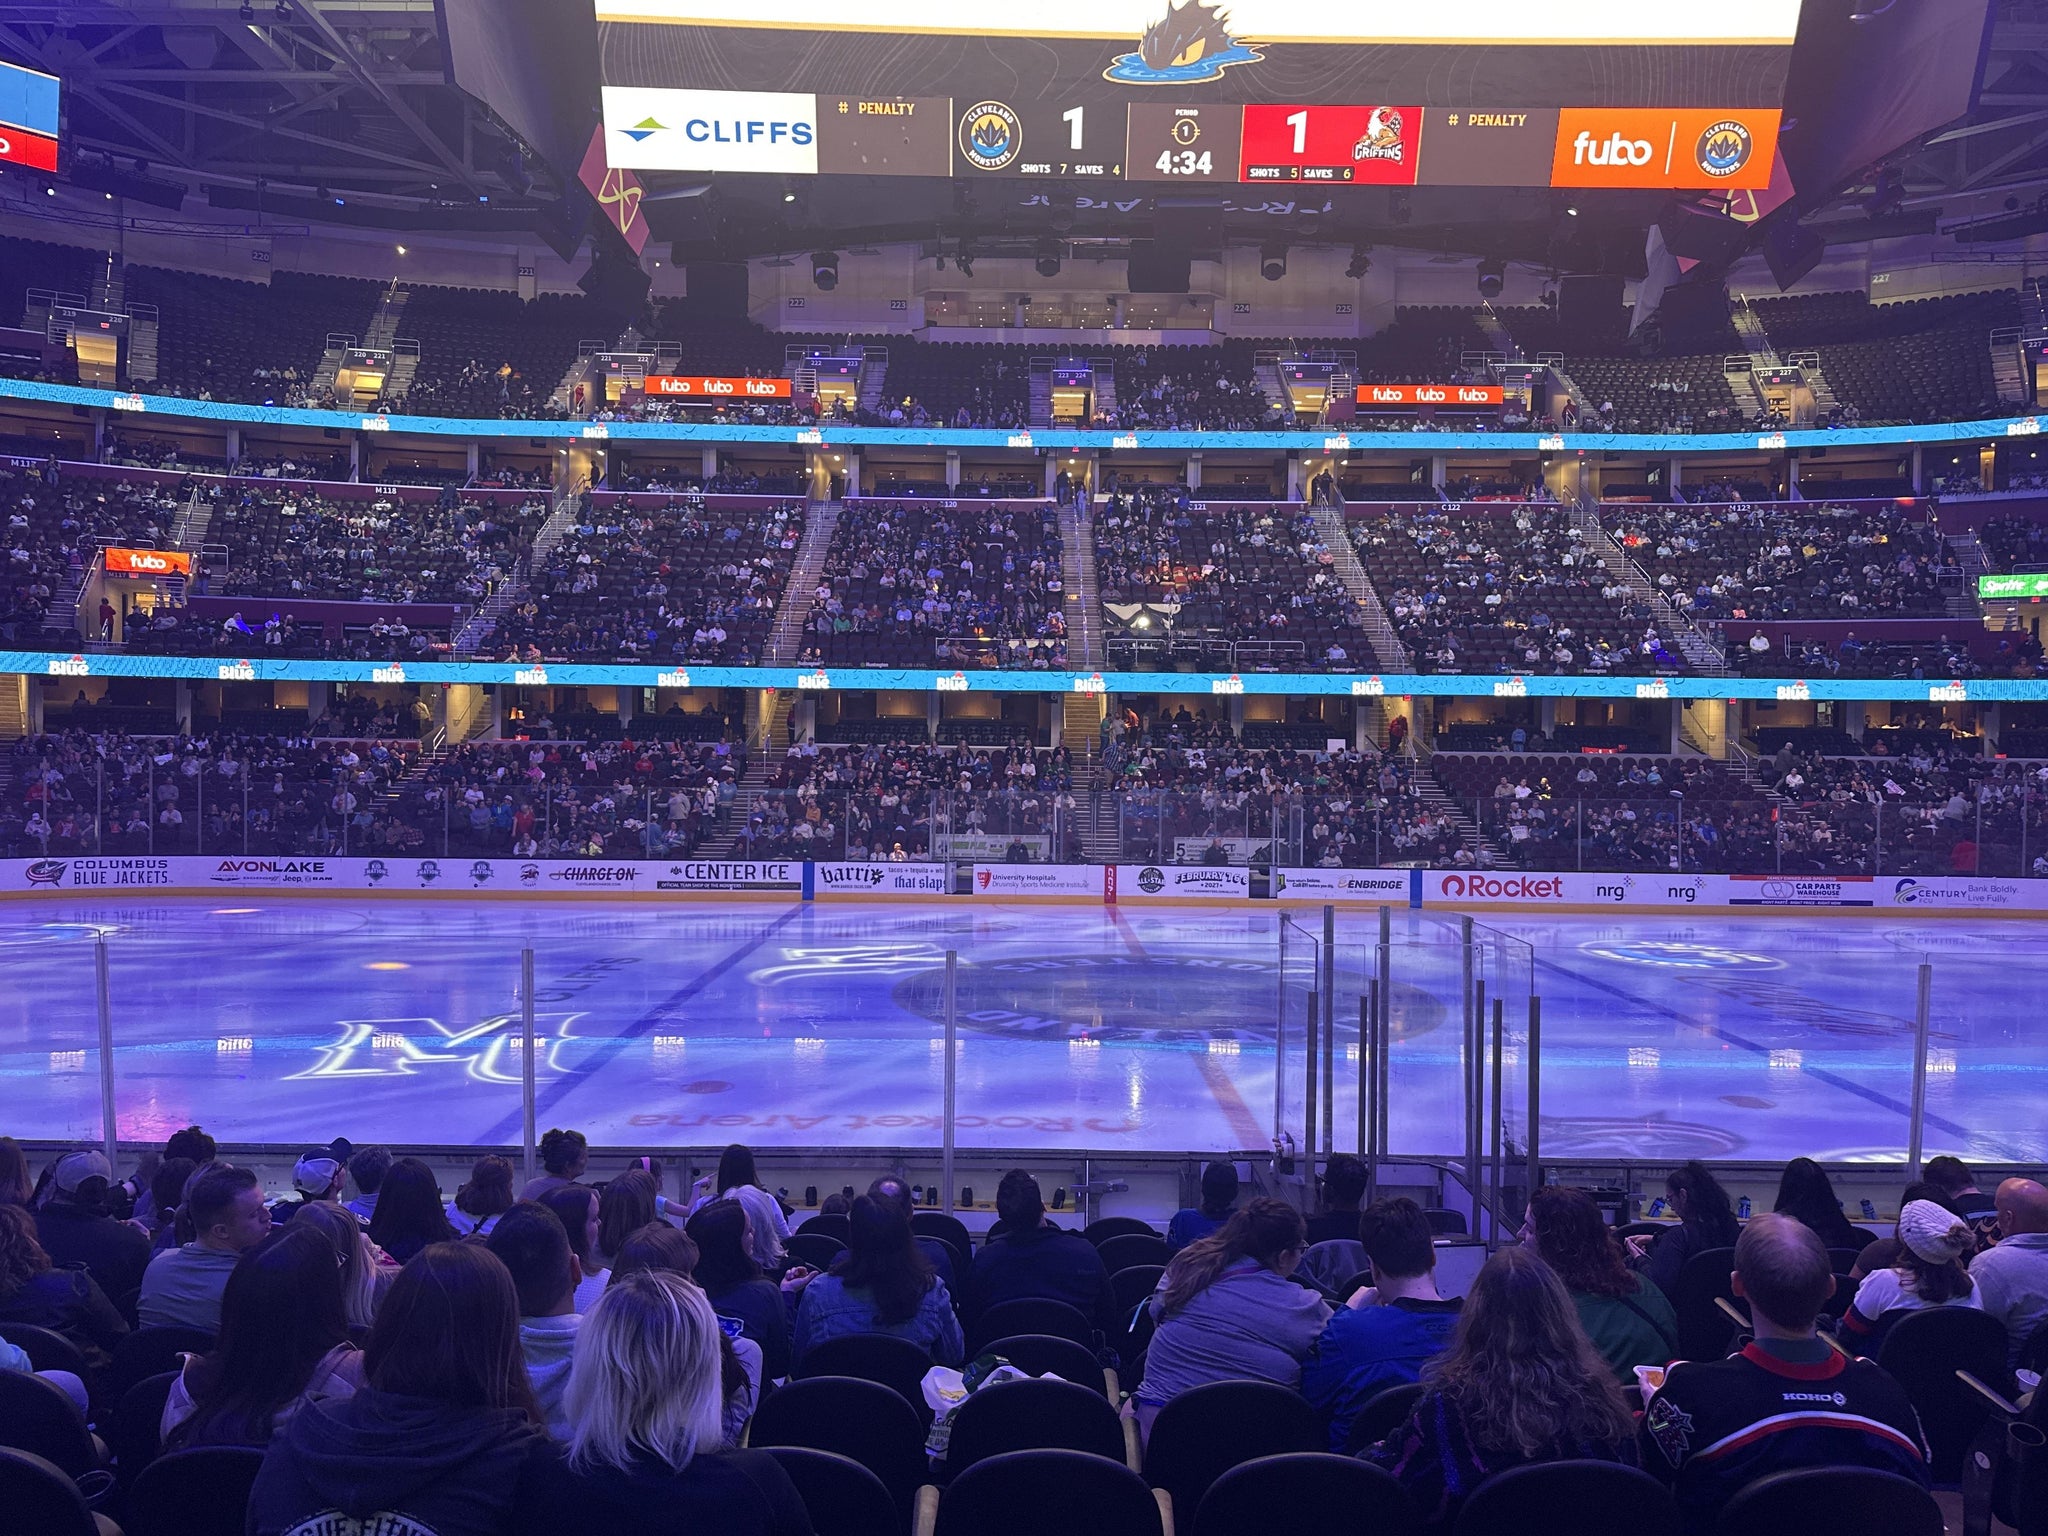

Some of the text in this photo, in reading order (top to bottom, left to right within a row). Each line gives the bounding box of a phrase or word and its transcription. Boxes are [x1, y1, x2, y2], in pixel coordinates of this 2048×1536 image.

[838, 101, 914, 116] # PENALTY
[967, 105, 1014, 124] CLEVELAND
[1175, 109, 1198, 117] PERIOD
[1448, 114, 1526, 126] # PENALTY
[686, 119, 812, 145] CLIFFS
[1062, 106, 1083, 150] 1
[1182, 125, 1188, 139] 1
[1286, 110, 1307, 154] 1
[1705, 124, 1747, 142] CLEVELAND
[968, 151, 1011, 167] MONSTERS
[1354, 145, 1403, 163] GRIFFINS
[1573, 140, 1652, 167] fubo
[1155, 150, 1212, 175] 4:34
[1702, 156, 1741, 174] MONSTERS
[1021, 163, 1120, 176] SHOTS 7 SAVES 4
[1250, 167, 1351, 179] SHOTS 5 SAVES 6
[253, 251, 270, 262] 220
[519, 268, 534, 276] 221
[1872, 274, 1890, 284] 227
[789, 299, 805, 307] 222
[892, 300, 906, 310] 223
[1235, 304, 1250, 312] 224
[1336, 305, 1352, 313] 225
[63, 309, 76, 318] 219
[2028, 341, 2042, 350] 227
[354, 350, 366, 358] 220
[373, 351, 386, 360] 221
[601, 354, 612, 362] 221
[811, 360, 822, 368] 222
[847, 360, 858, 368] 223
[1322, 365, 1333, 373] 225
[1531, 366, 1543, 374] 226
[1058, 371, 1069, 379] 223
[1075, 371, 1086, 379] 224
[1760, 369, 1773, 378] 226
[1779, 368, 1793, 377] 227
[661, 379, 775, 394] fubo fubo fubo
[1373, 388, 1488, 401] fubo fubo fubo
[385, 487, 397, 495] 118
[1194, 503, 1206, 511] 121
[1441, 503, 1460, 511] C 122
[1738, 504, 1750, 512] 123
[130, 553, 167, 570] fubo
[1983, 579, 2026, 594] Sprite
[49, 660, 90, 676] Blue
[219, 665, 255, 680] Blue
[372, 667, 406, 683] Blue
[515, 671, 548, 685] Blue
[657, 673, 690, 687] Blue
[797, 675, 830, 689] Blue
[936, 677, 968, 691] Blue
[1074, 679, 1106, 693] Blue
[1212, 680, 1244, 694] Blue
[1352, 681, 1384, 695] Blue
[1494, 682, 1527, 696] Blue
[1636, 684, 1669, 698] Blue
[1777, 686, 1810, 700] Blue
[1929, 686, 1967, 701] Blue
[1176, 843, 1185, 857] 5
[74, 860, 168, 870] COLUMBUS
[217, 861, 325, 872] AVONLAKE
[685, 863, 790, 880] CENTER ICE
[74, 871, 168, 884] BLUE JACKETS
[894, 875, 916, 889] that
[992, 874, 1056, 883] University Hospitals
[1174, 871, 1224, 884] FEBRUARY
[1021, 881, 1038, 889] Sports
[1348, 880, 1403, 889] ENBRIDGE
[1469, 875, 1563, 897] Rocket
[1795, 883, 1841, 891] CAR PARTS
[1918, 884, 2019, 898] CENTURY Bank Boldly.
[1597, 886, 1624, 901] nrg
[1668, 887, 1695, 902] nrg
[1968, 893, 1986, 902] Live
[1987, 894, 2009, 904] Fully.
[1781, 1392, 1832, 1402] KOHO
